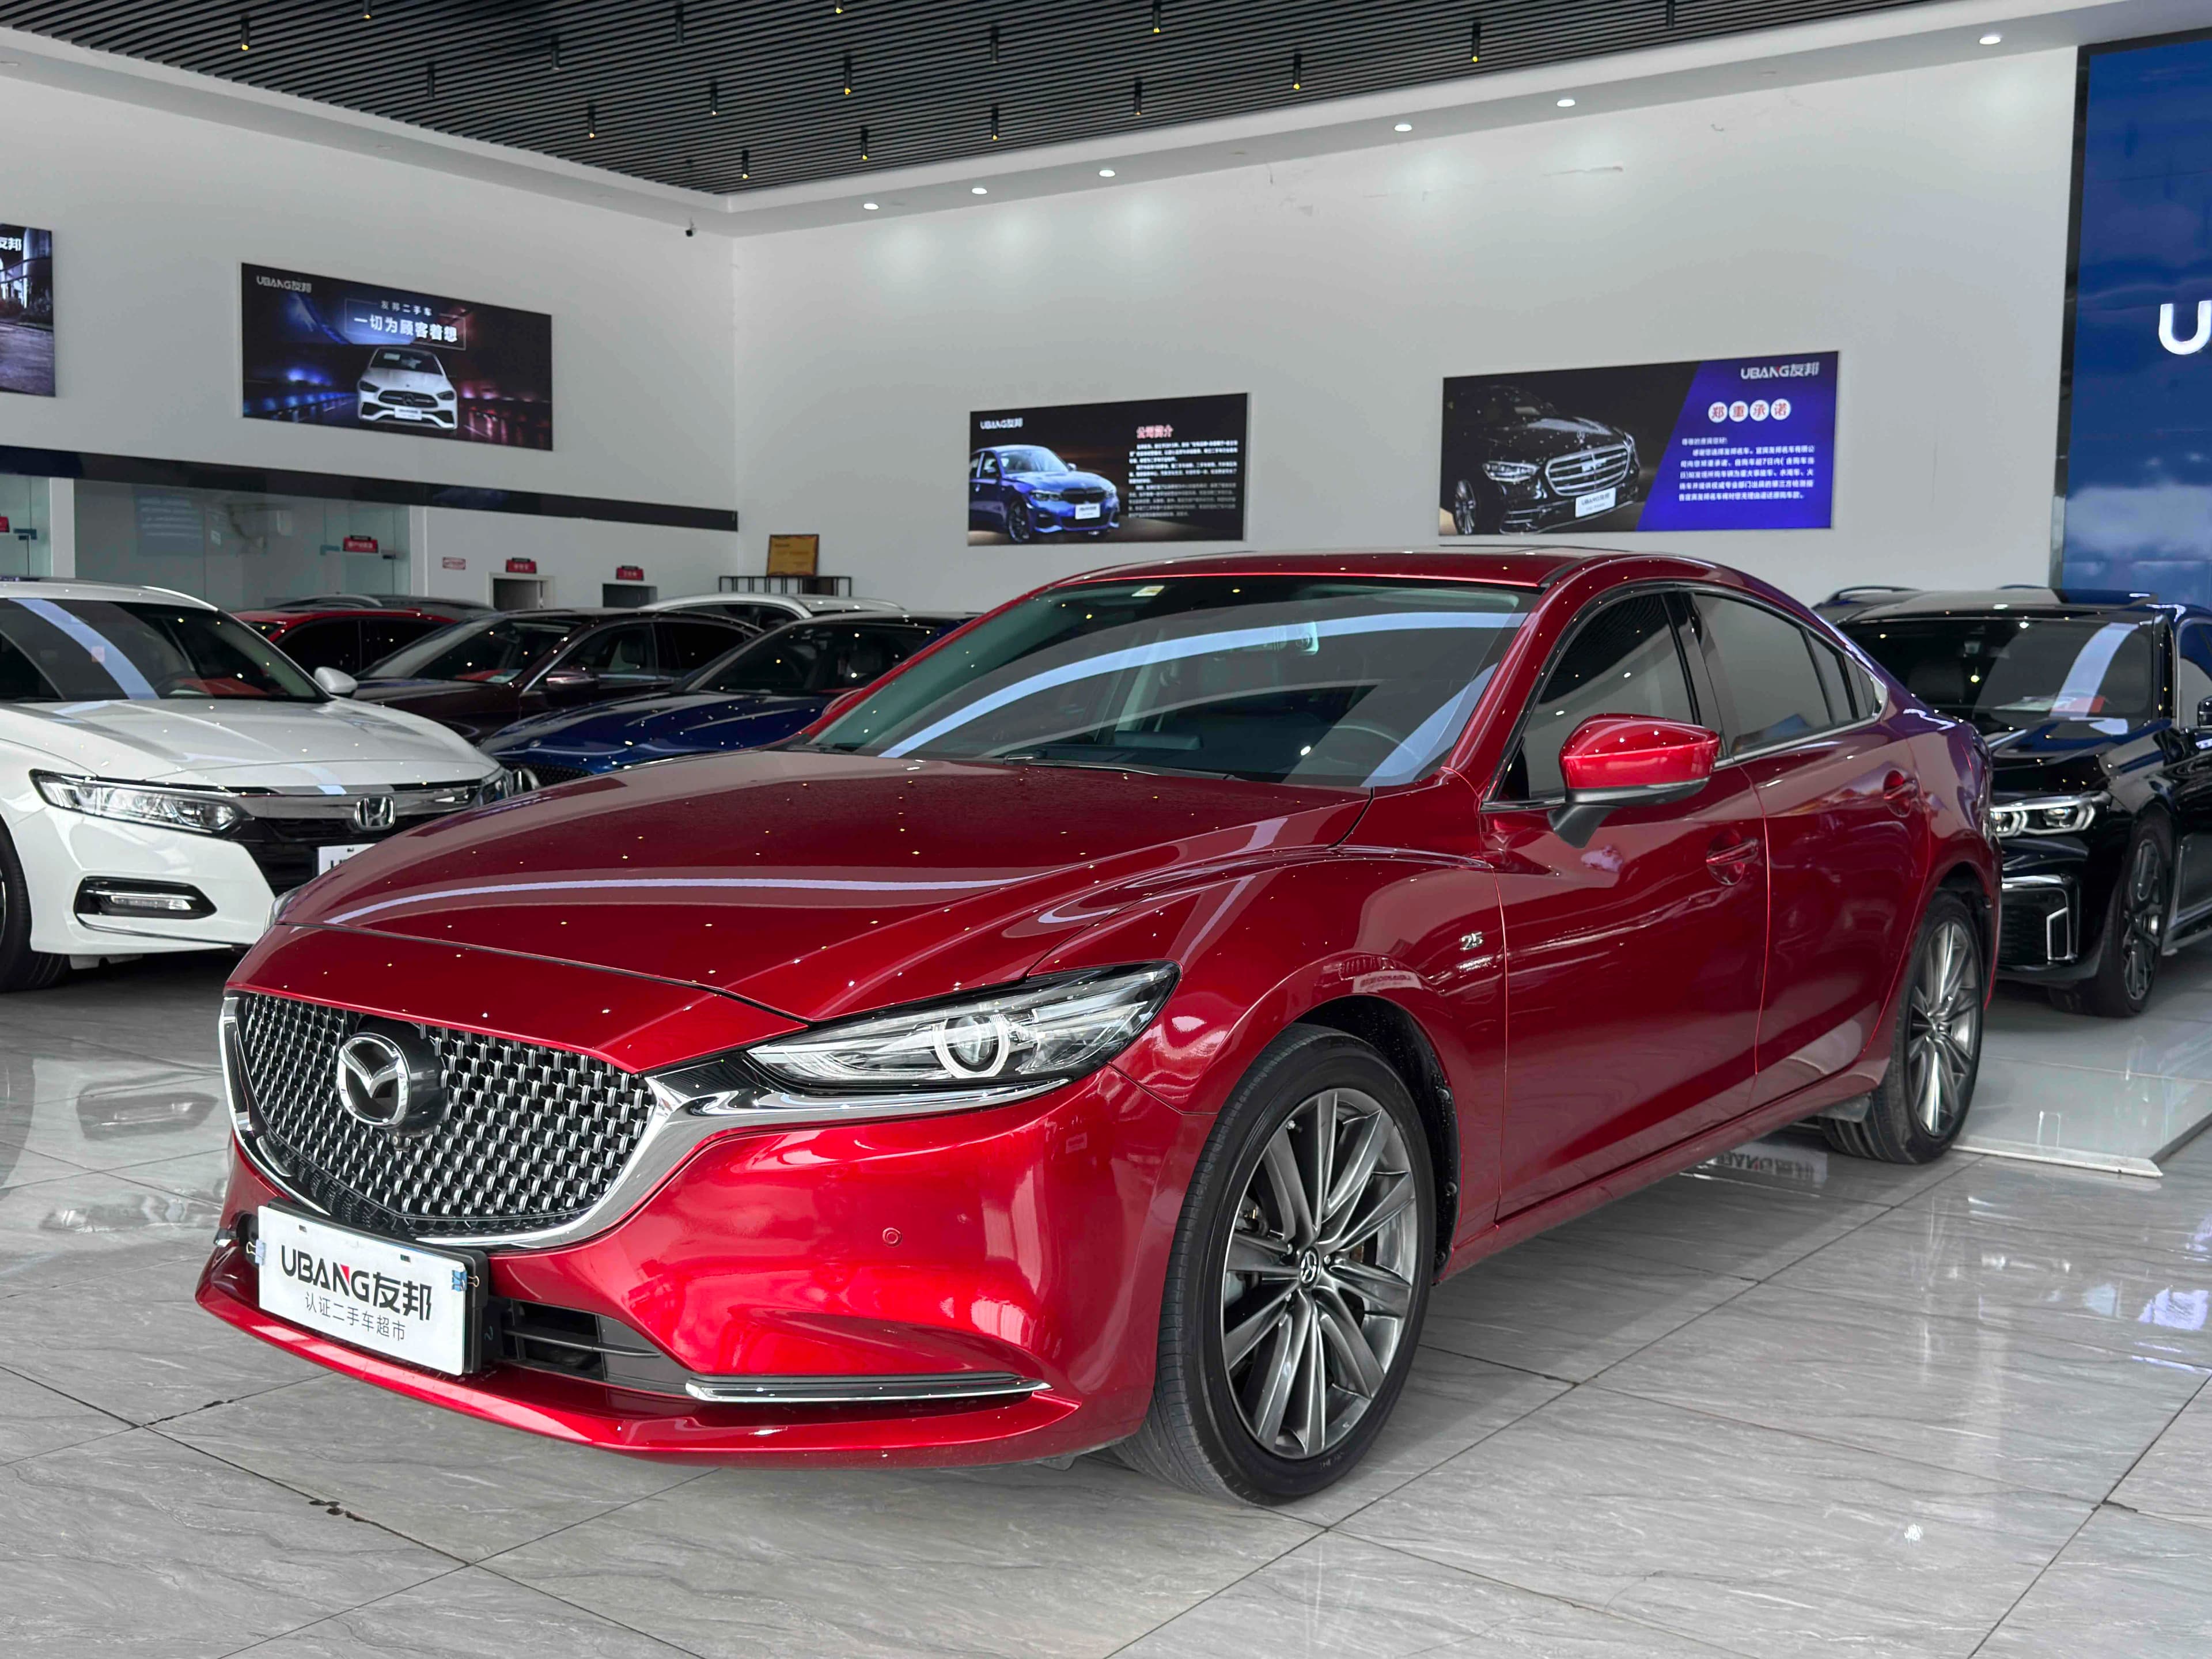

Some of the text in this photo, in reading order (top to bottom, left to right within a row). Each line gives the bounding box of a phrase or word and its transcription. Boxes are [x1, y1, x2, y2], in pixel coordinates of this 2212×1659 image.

[354, 314, 457, 342] 一切为顾客着想
[2158, 300, 2212, 355] U
[1740, 362, 1820, 380] UBANG友邦
[1712, 403, 1787, 419] 郑重承诺
[281, 1244, 432, 1321] UBANG友邦
[305, 1291, 406, 1341] 认证二手车超市
